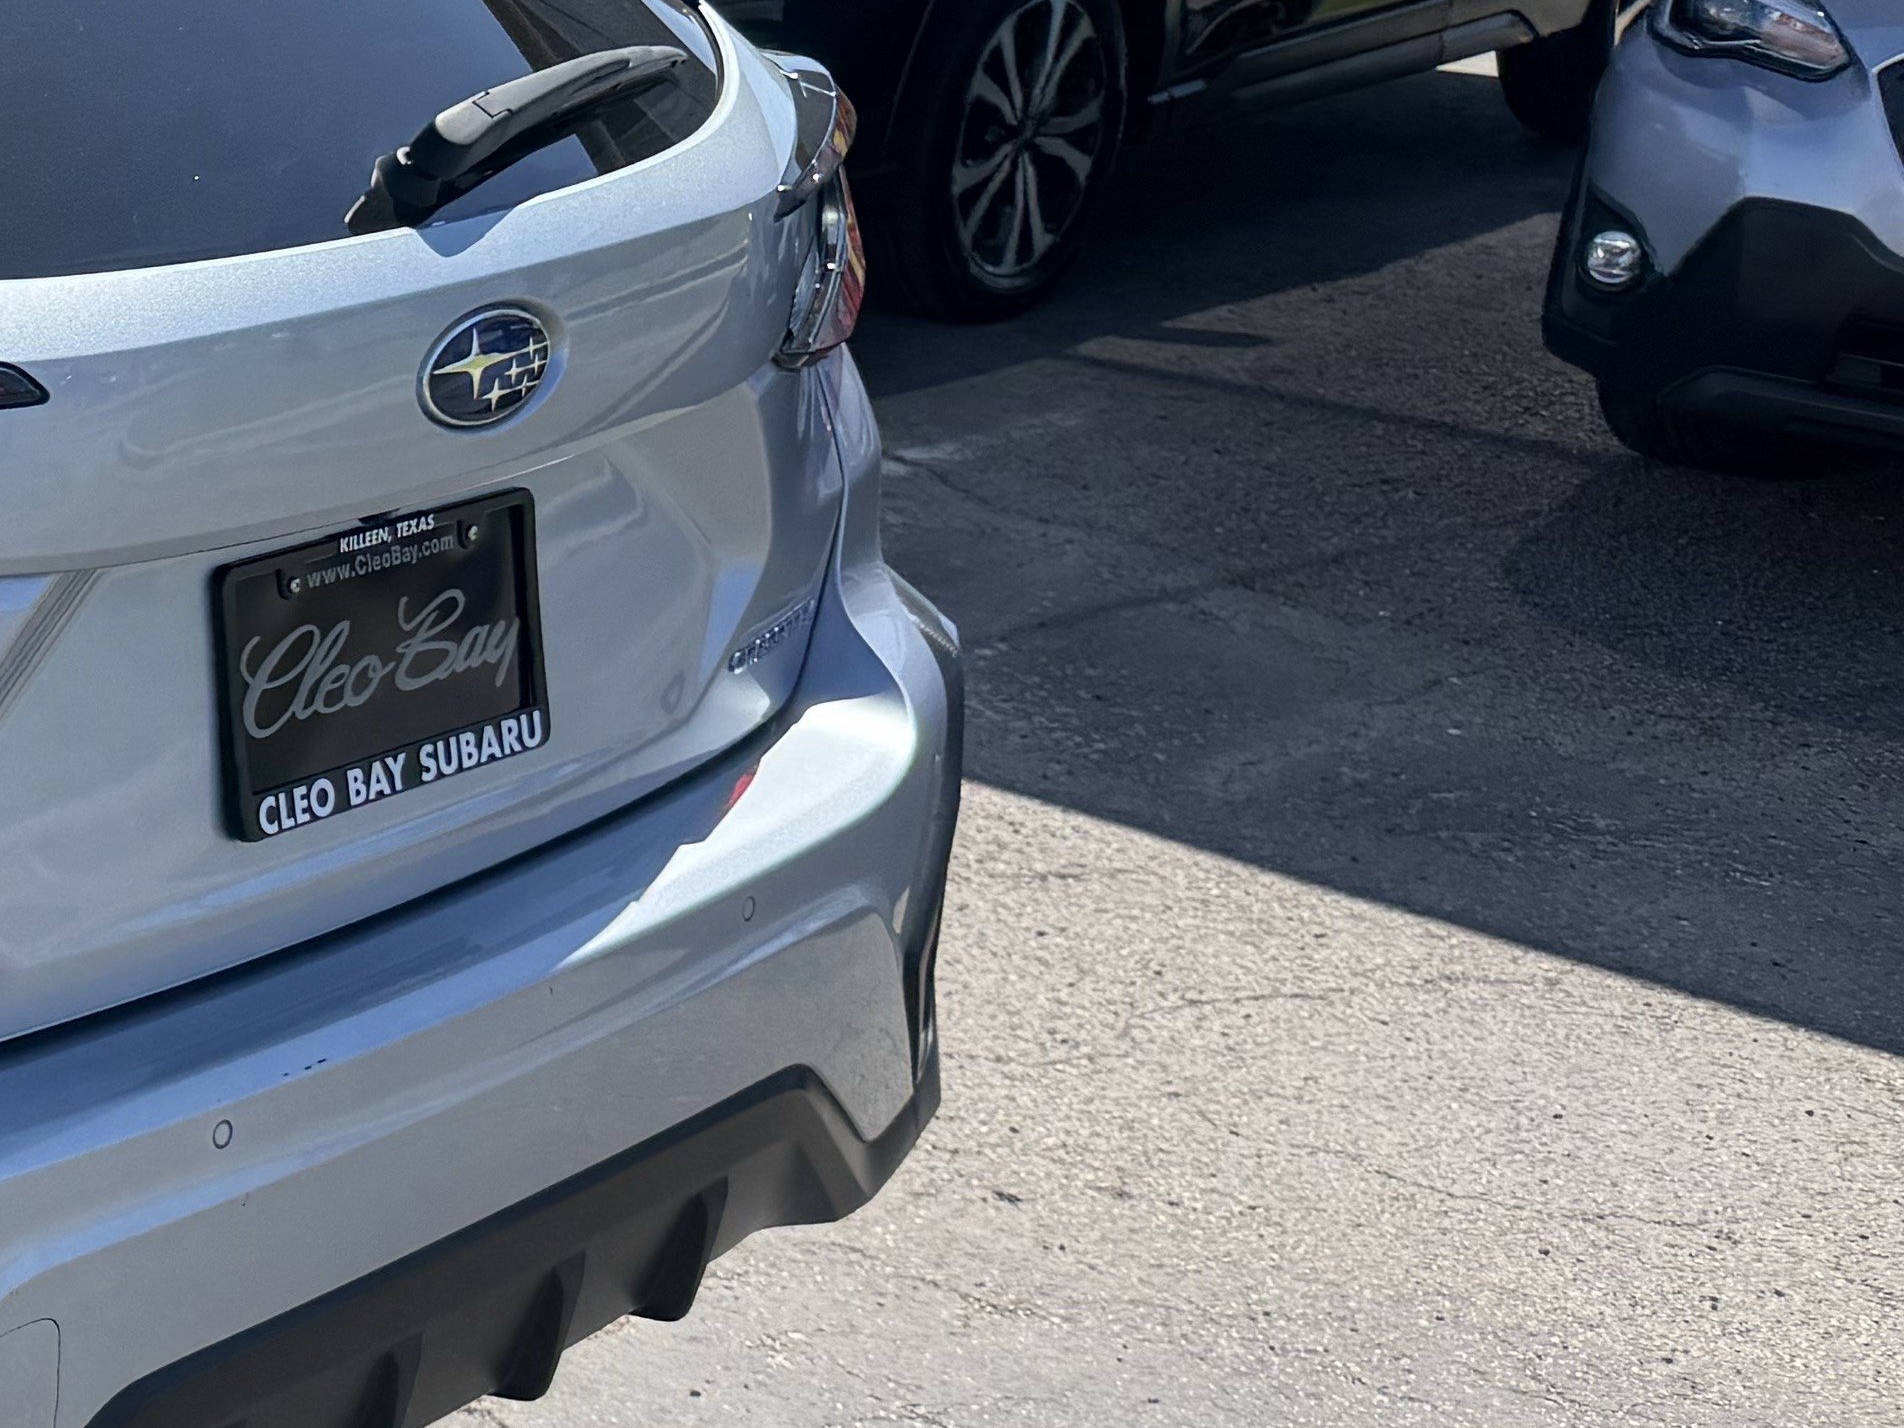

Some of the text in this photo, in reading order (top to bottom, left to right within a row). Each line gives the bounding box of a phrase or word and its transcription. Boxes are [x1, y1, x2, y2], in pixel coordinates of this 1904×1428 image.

[306, 533, 454, 589] www.CleoBay.com
[339, 513, 436, 554] KILLEEN, TEXAS
[240, 588, 520, 739] Cleo Bay
[258, 709, 543, 836] CLEO BAY SUBARU
